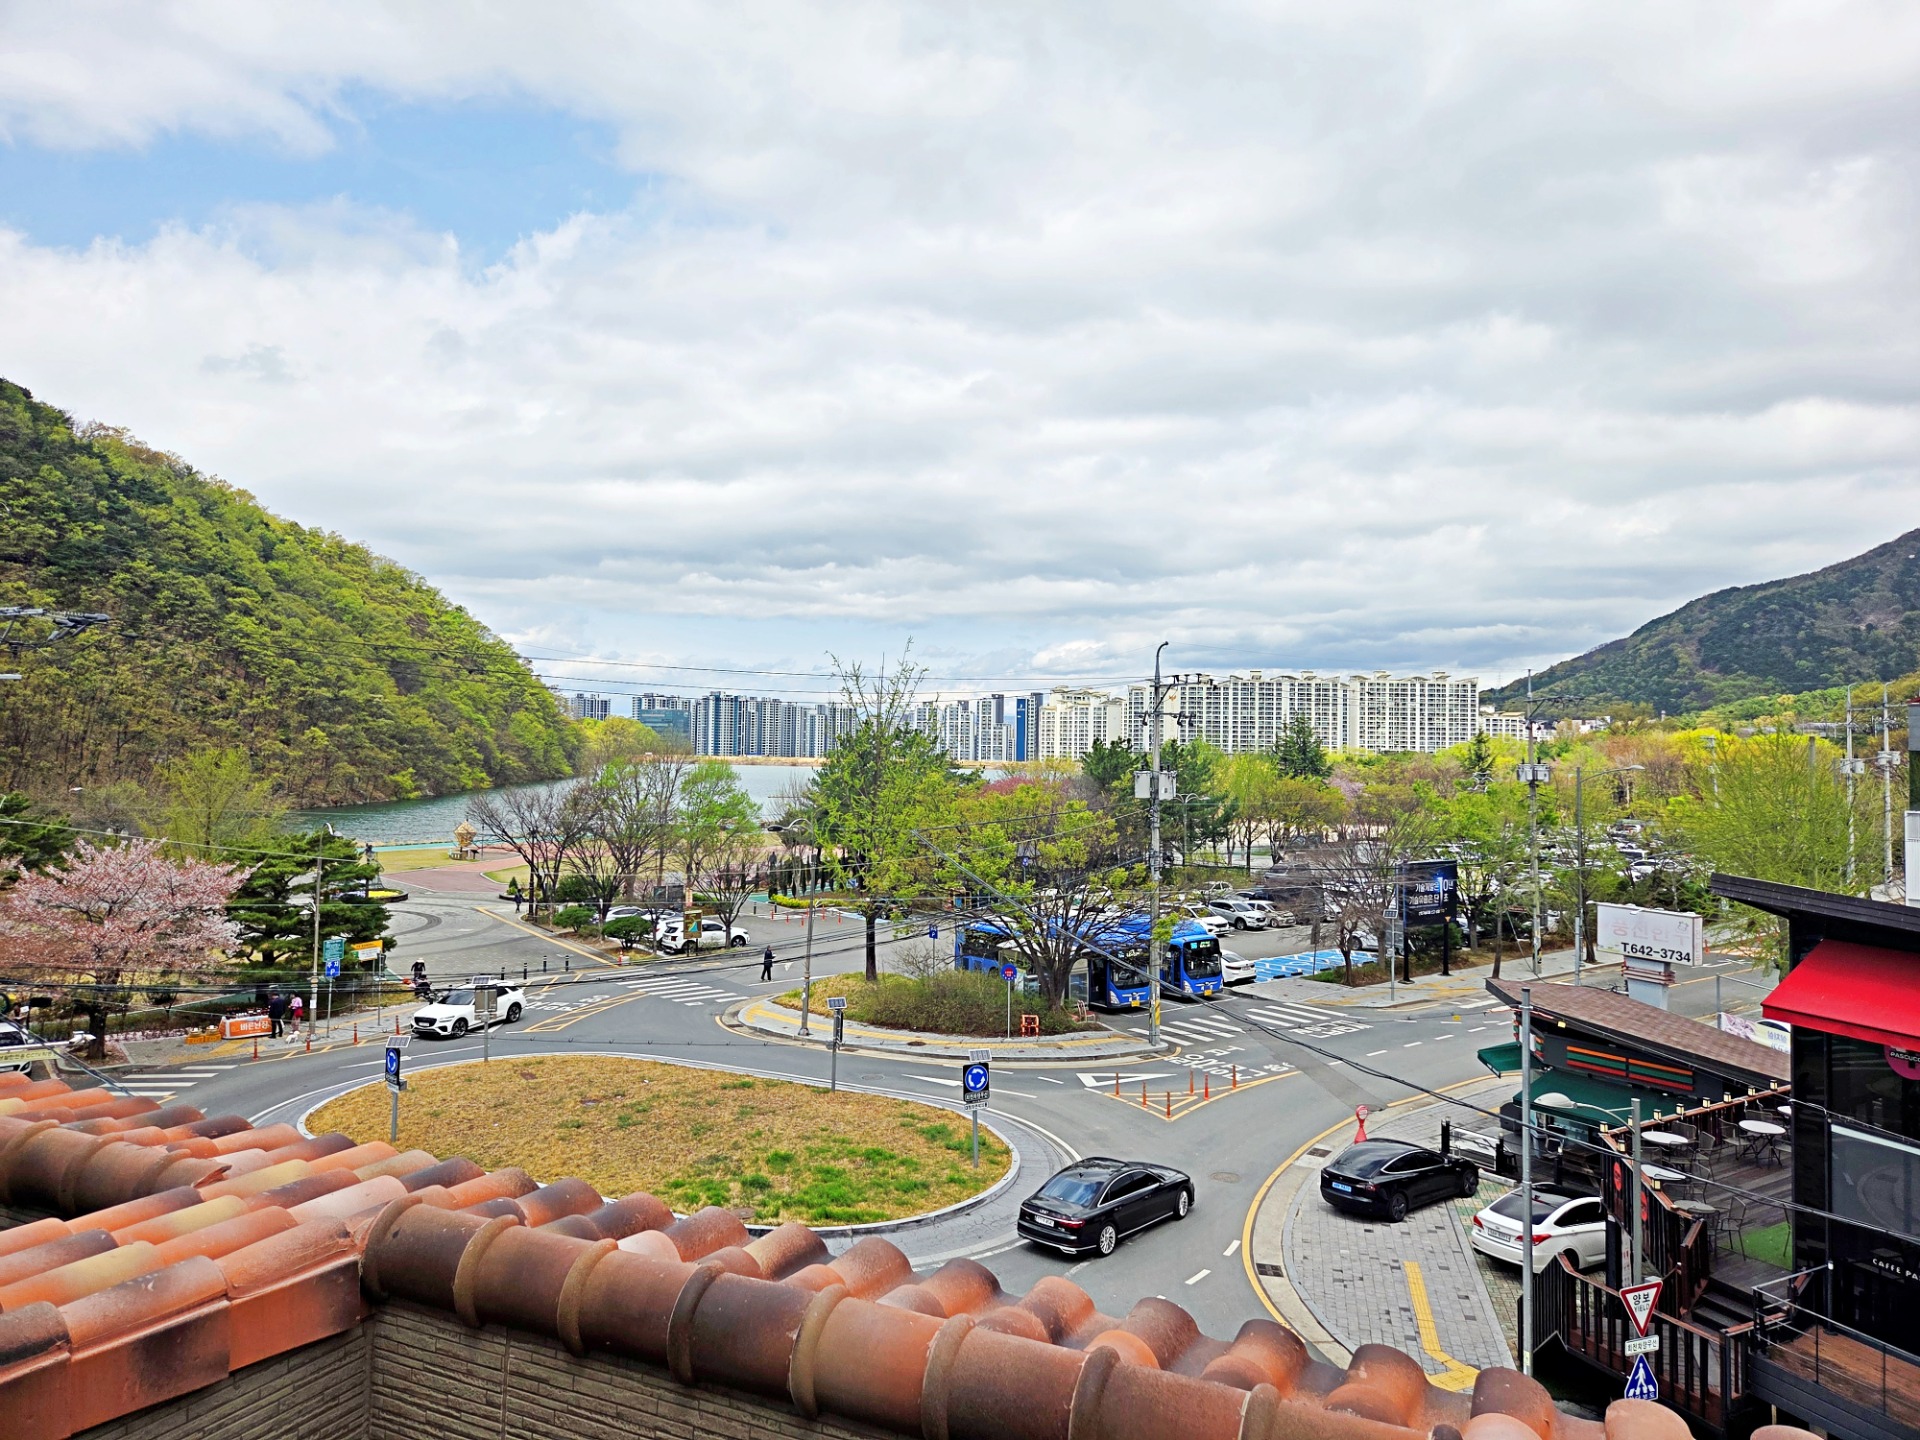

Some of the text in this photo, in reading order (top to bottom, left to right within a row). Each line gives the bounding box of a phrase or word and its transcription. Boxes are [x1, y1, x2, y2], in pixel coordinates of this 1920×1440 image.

[1621, 942, 1691, 962] T.642-3734
[1872, 1258, 1920, 1281] CAFFE PA
[1633, 1292, 1650, 1305] 양보
[1634, 1303, 1650, 1313] YIELD
